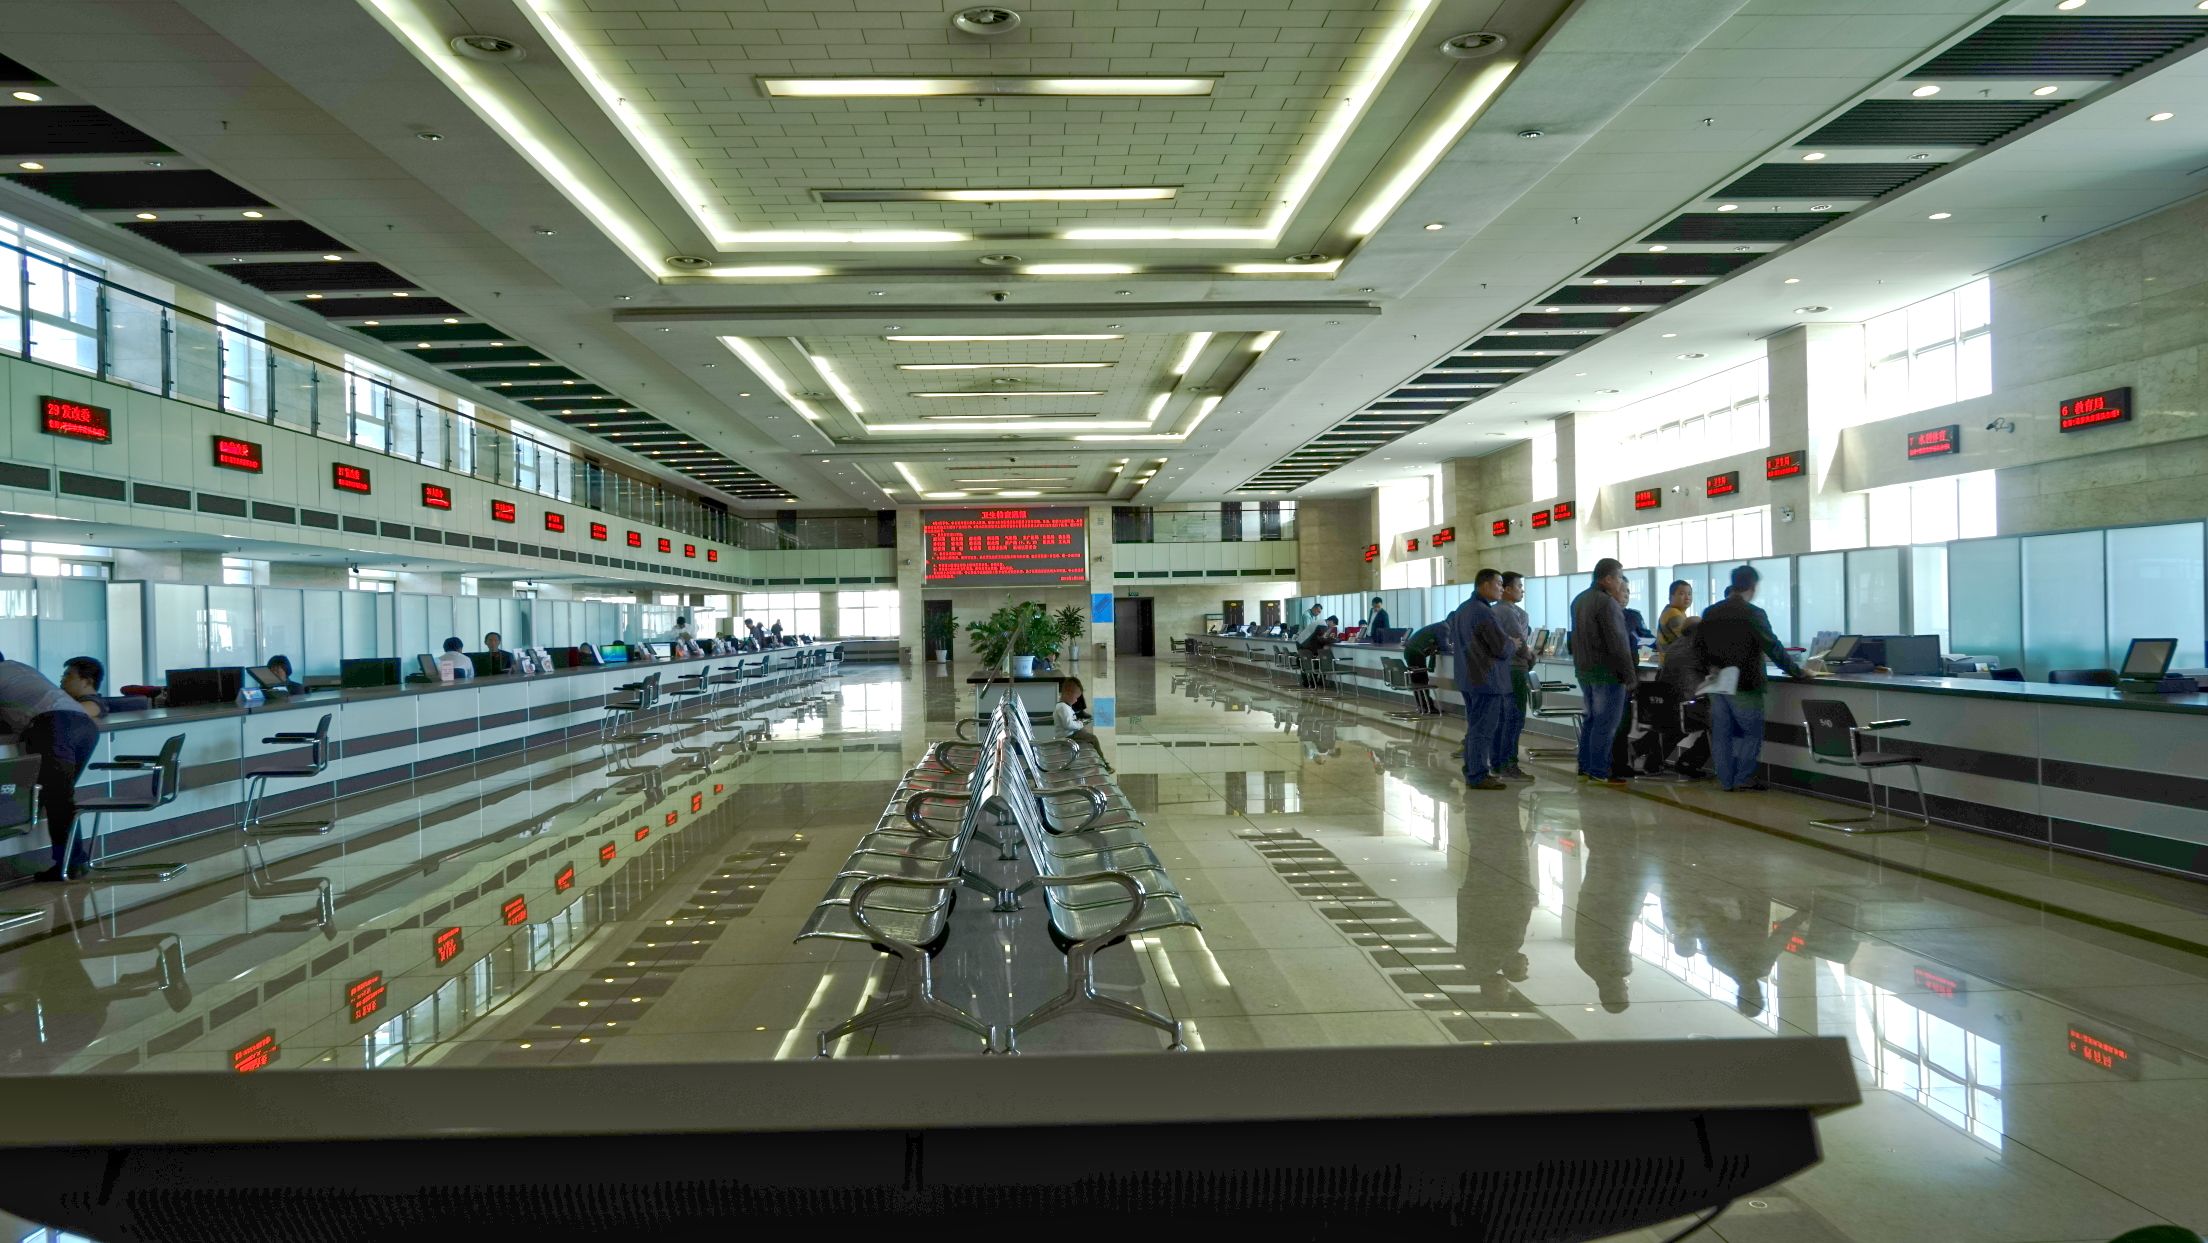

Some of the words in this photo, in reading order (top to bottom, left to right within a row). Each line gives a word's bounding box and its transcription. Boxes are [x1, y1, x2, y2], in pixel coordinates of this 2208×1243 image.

[47, 403, 60, 416] 29
[61, 404, 90, 423] 发改委
[2061, 406, 2068, 416] 6
[2074, 396, 2104, 415] 教育局
